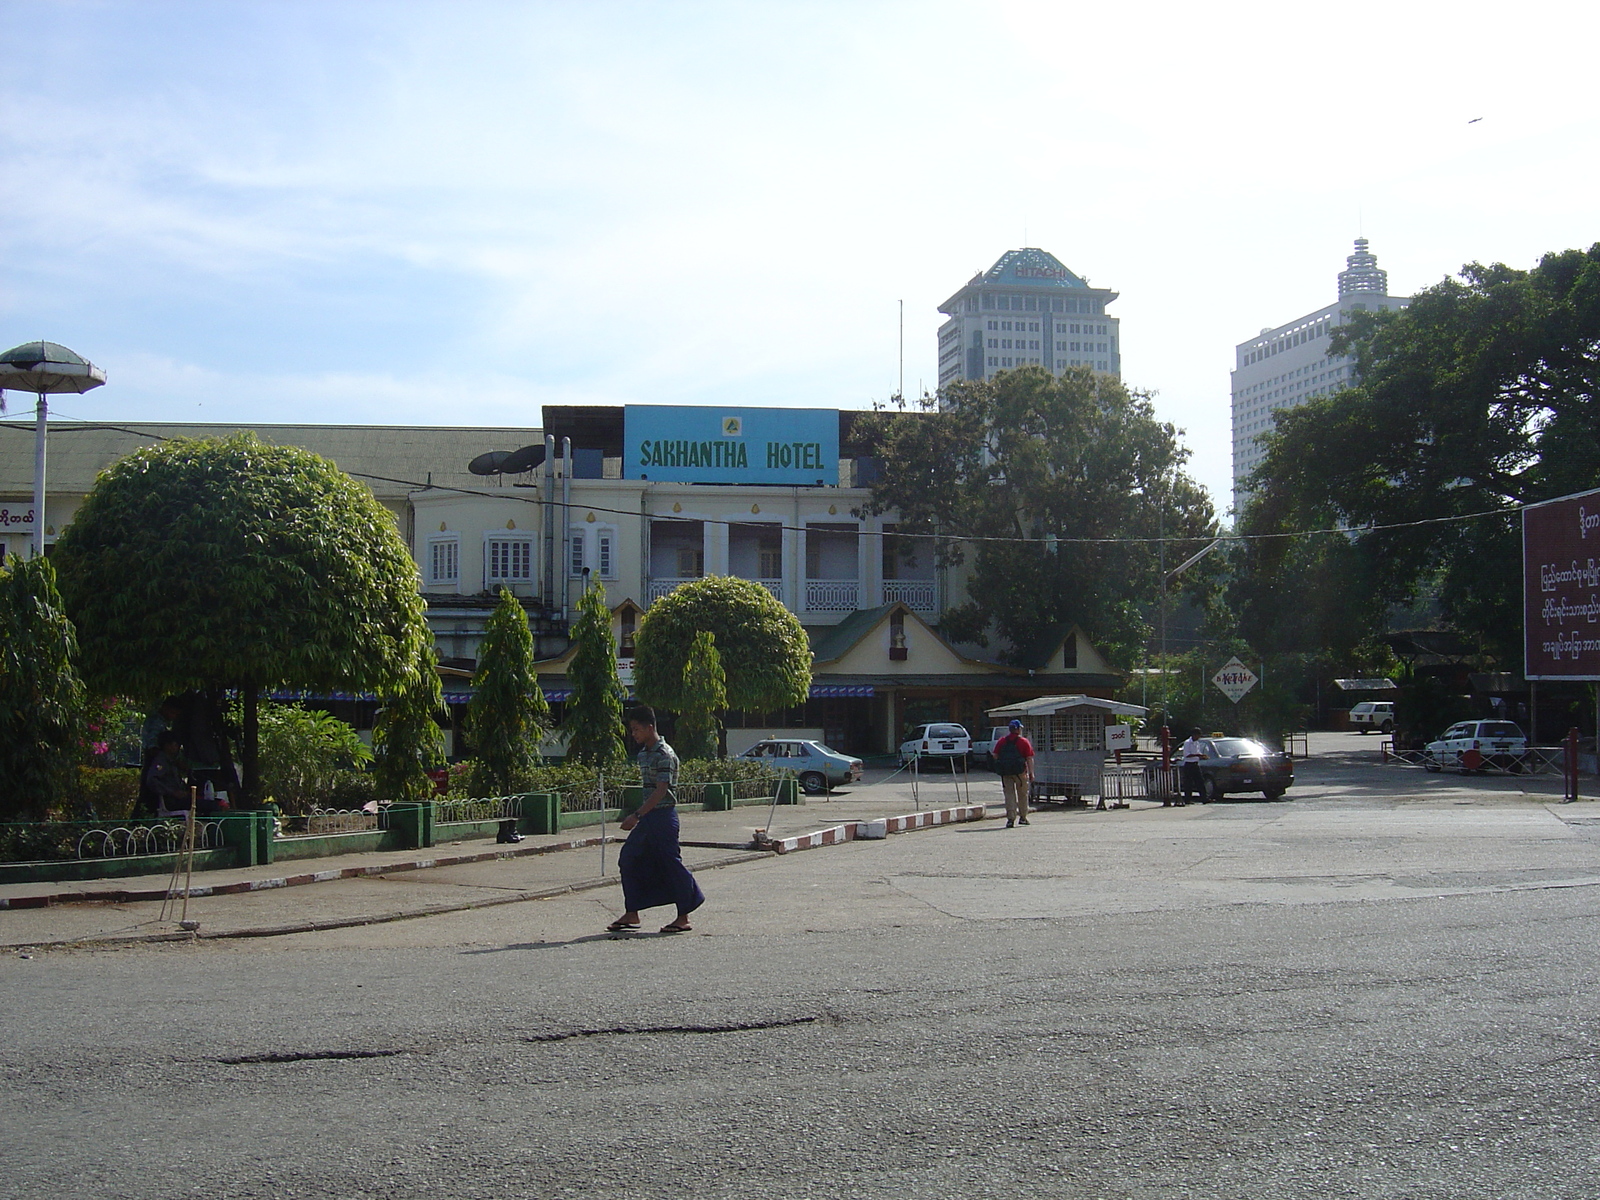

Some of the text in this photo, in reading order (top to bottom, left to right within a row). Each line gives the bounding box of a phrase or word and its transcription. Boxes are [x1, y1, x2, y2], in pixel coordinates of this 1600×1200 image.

[1015, 267, 1066, 278] HITACHI
[640, 440, 825, 469] SAKHANTHA HOTEL
